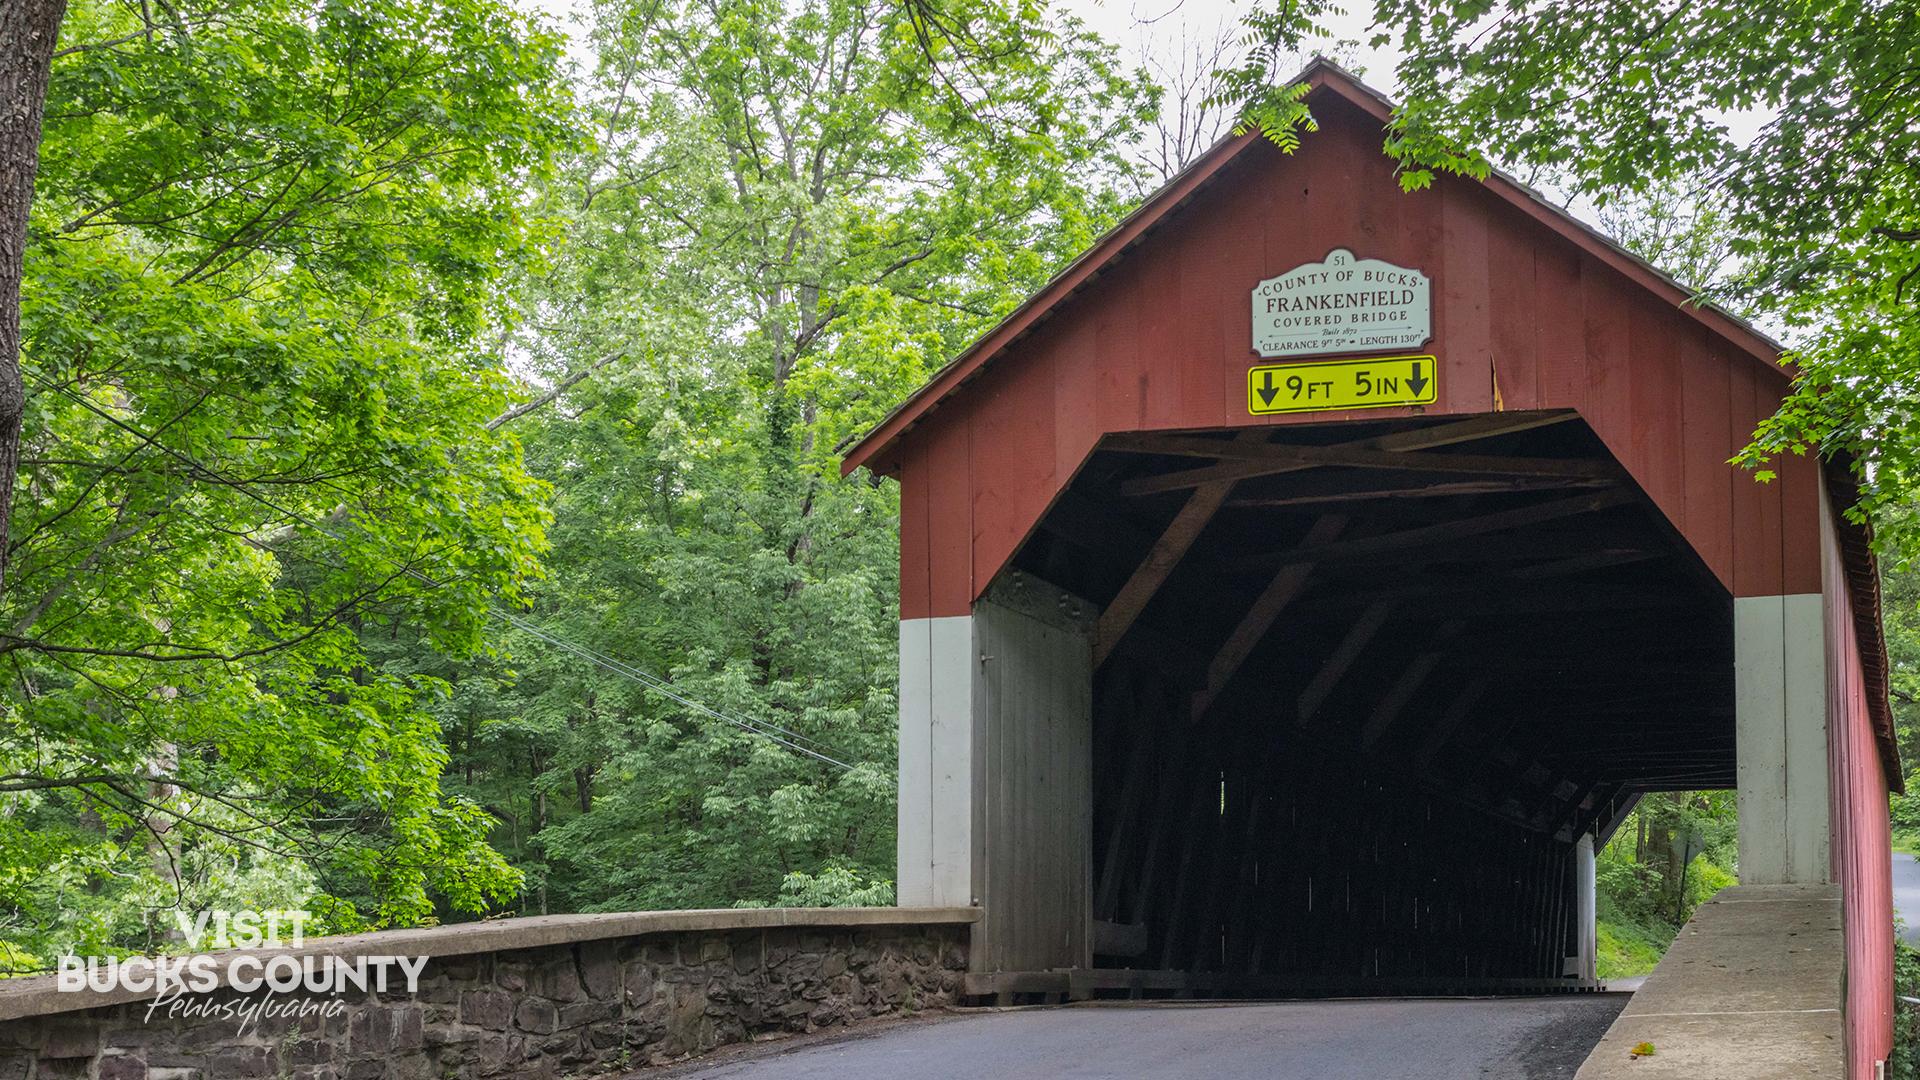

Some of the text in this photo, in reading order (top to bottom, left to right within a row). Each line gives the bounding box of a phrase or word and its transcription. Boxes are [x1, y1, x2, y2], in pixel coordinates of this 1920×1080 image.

[1334, 255, 1345, 266] 51
[1262, 270, 1418, 297] COUNTY OF BUCKS
[1266, 289, 1415, 313] FRANKENFIELD
[1273, 311, 1407, 328] COVERED BRIDGE
[1262, 340, 1319, 352] CLEARANCE
[1360, 335, 1398, 346] LENGTH
